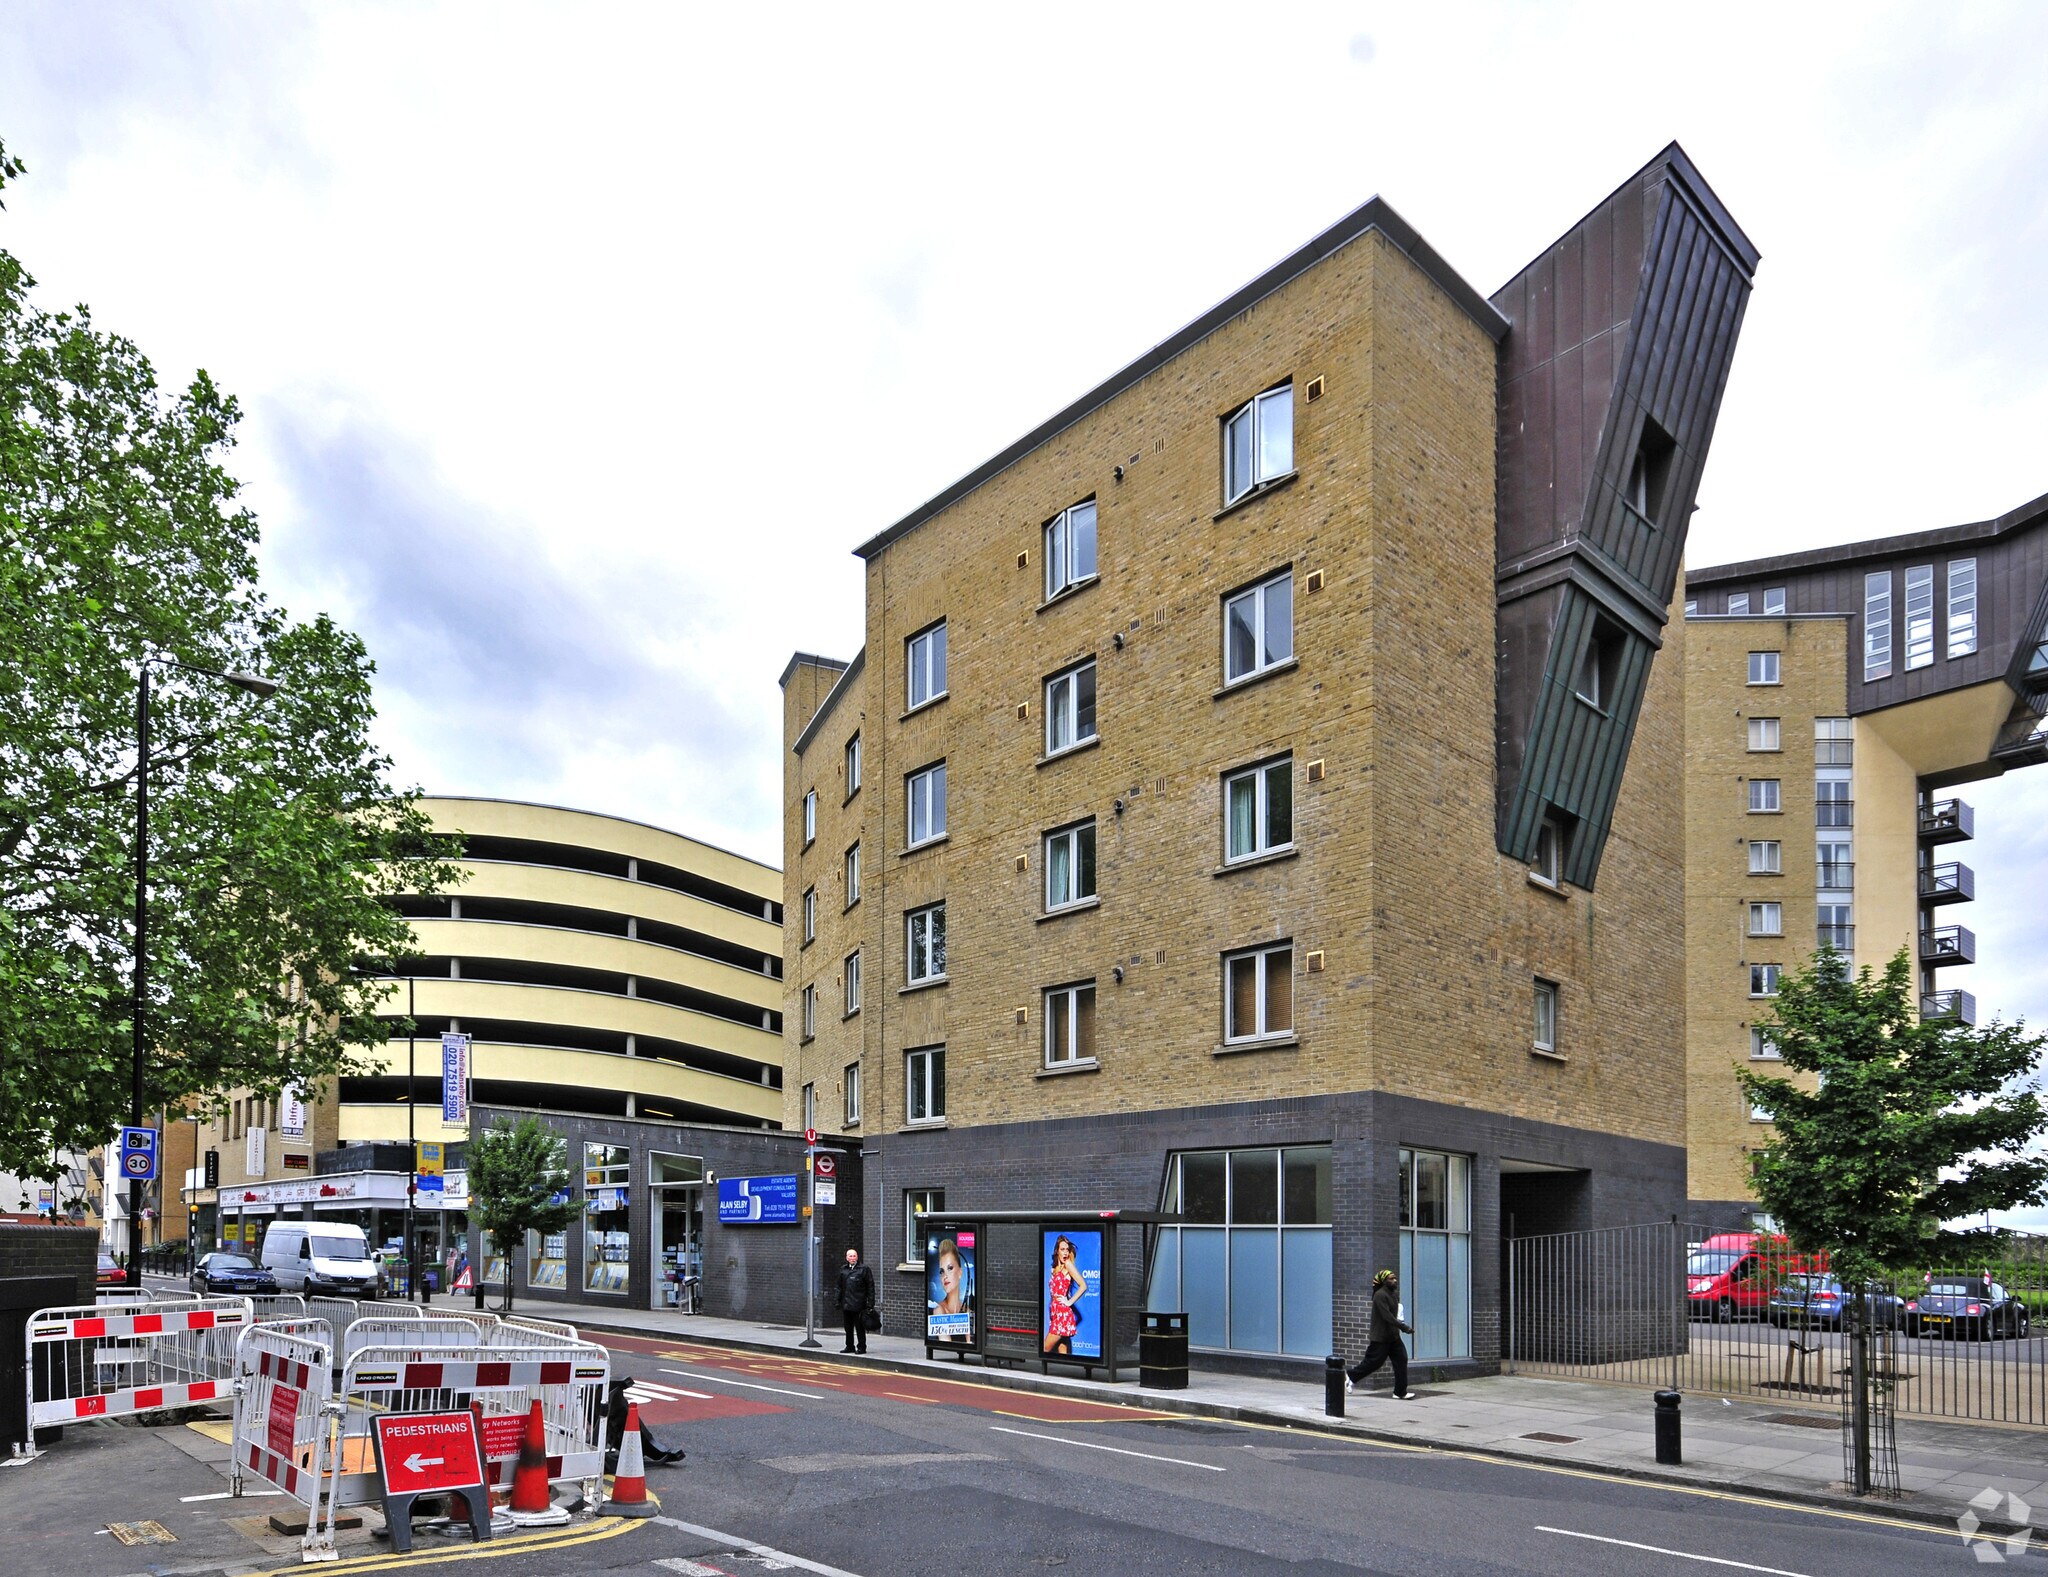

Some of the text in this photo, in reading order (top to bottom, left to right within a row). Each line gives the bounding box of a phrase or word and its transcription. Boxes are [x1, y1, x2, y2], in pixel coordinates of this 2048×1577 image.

[448, 1047, 458, 1066] 020
[448, 1068, 458, 1092] 7519
[448, 1095, 458, 1118] 5900
[808, 1131, 816, 1142] U
[130, 1159, 148, 1168] 30
[734, 1200, 748, 1208] SELBY
[1082, 1270, 1100, 1278] OMG!
[386, 1422, 467, 1437] PEDESTRIANS
